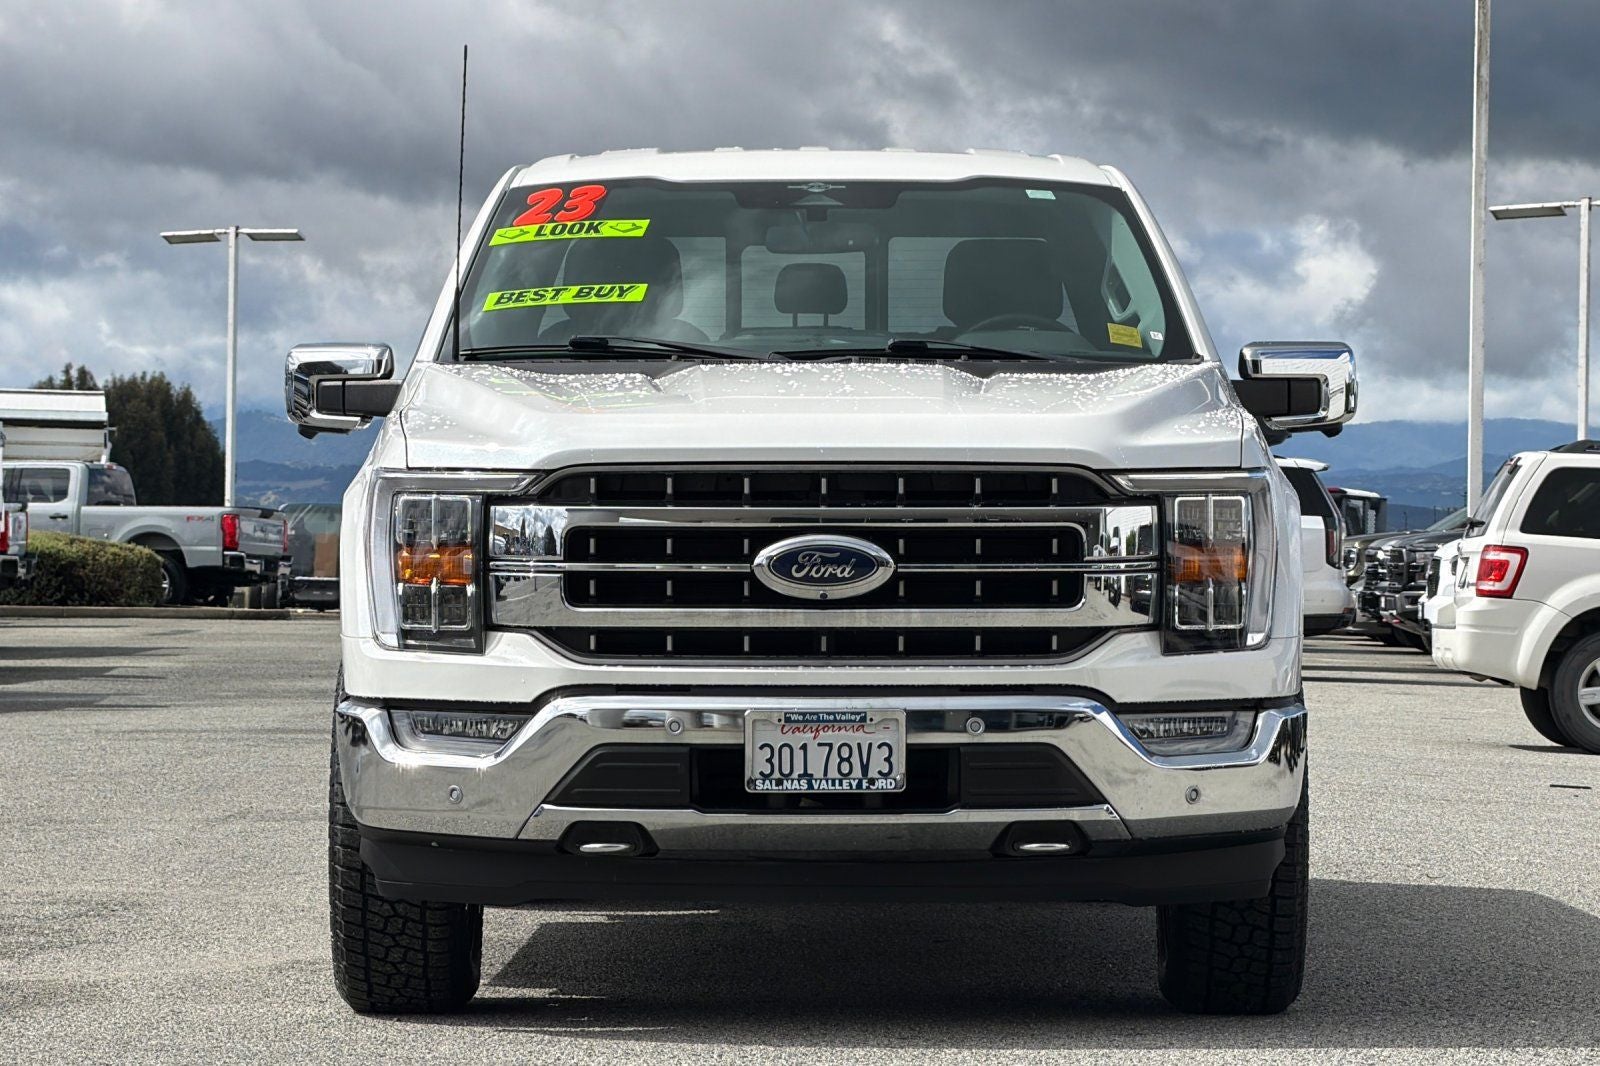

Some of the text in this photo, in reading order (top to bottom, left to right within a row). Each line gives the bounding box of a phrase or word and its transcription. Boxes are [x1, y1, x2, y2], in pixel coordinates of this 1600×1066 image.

[513, 185, 607, 226] 23
[534, 222, 606, 238] LOOK
[493, 284, 638, 306] BEST BUY
[791, 551, 857, 578] Ford
[804, 713, 818, 721] Are
[819, 713, 836, 721] The
[758, 742, 894, 778] 30178V3
[755, 779, 808, 790] SALNAS
[812, 779, 857, 790] VALLEY
